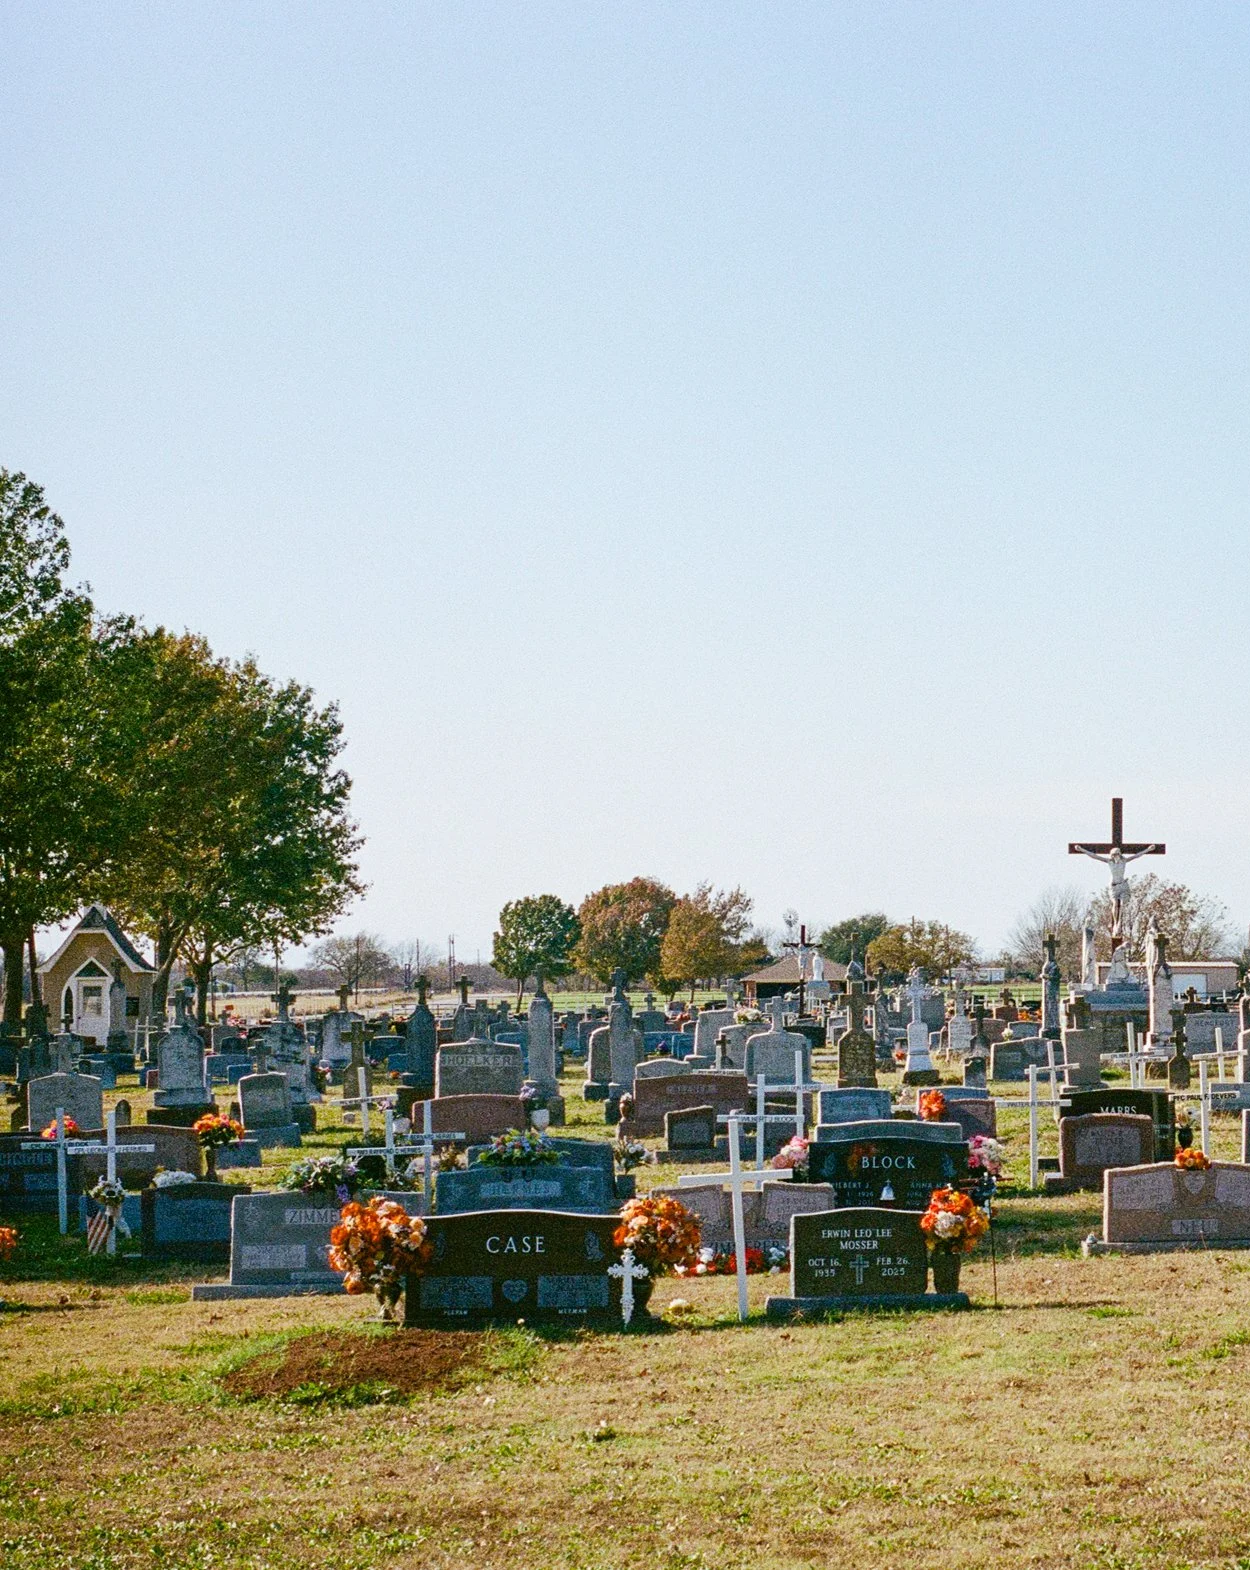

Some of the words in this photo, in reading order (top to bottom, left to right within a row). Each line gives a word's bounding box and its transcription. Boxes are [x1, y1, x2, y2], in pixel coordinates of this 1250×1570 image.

[861, 1156, 916, 1169] BLOCK
[289, 1209, 338, 1224] ZIMME
[821, 1229, 851, 1239] ERWIN
[854, 1229, 873, 1238] LEO
[876, 1228, 893, 1238] LEE
[486, 1236, 546, 1254] CASE
[840, 1240, 879, 1250] MOSSER
[808, 1258, 826, 1267] OCT
[814, 1268, 836, 1278] 1935
[881, 1267, 906, 1277] 2025
